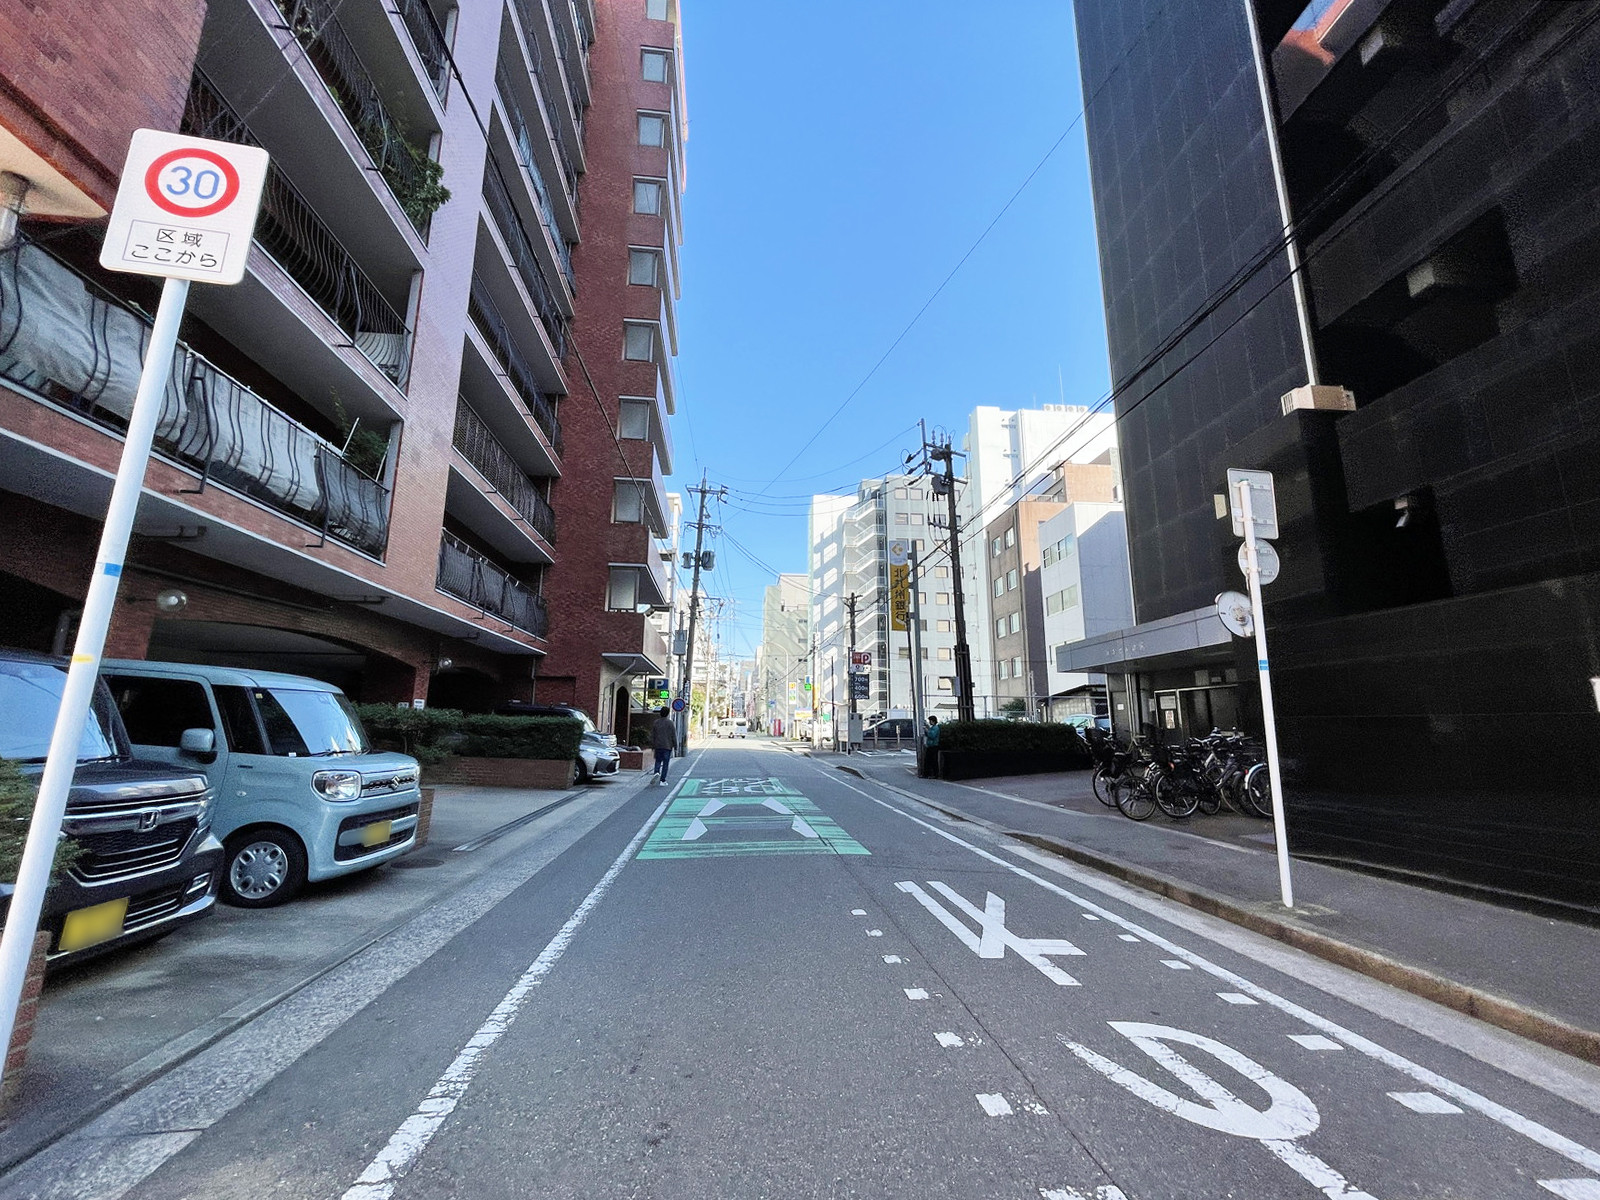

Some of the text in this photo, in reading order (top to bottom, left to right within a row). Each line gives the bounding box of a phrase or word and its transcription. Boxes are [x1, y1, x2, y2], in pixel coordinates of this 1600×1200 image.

[166, 166, 220, 199] 30
[156, 228, 203, 247] 区域
[131, 244, 217, 268] ここから
[654, 680, 664, 690] P
